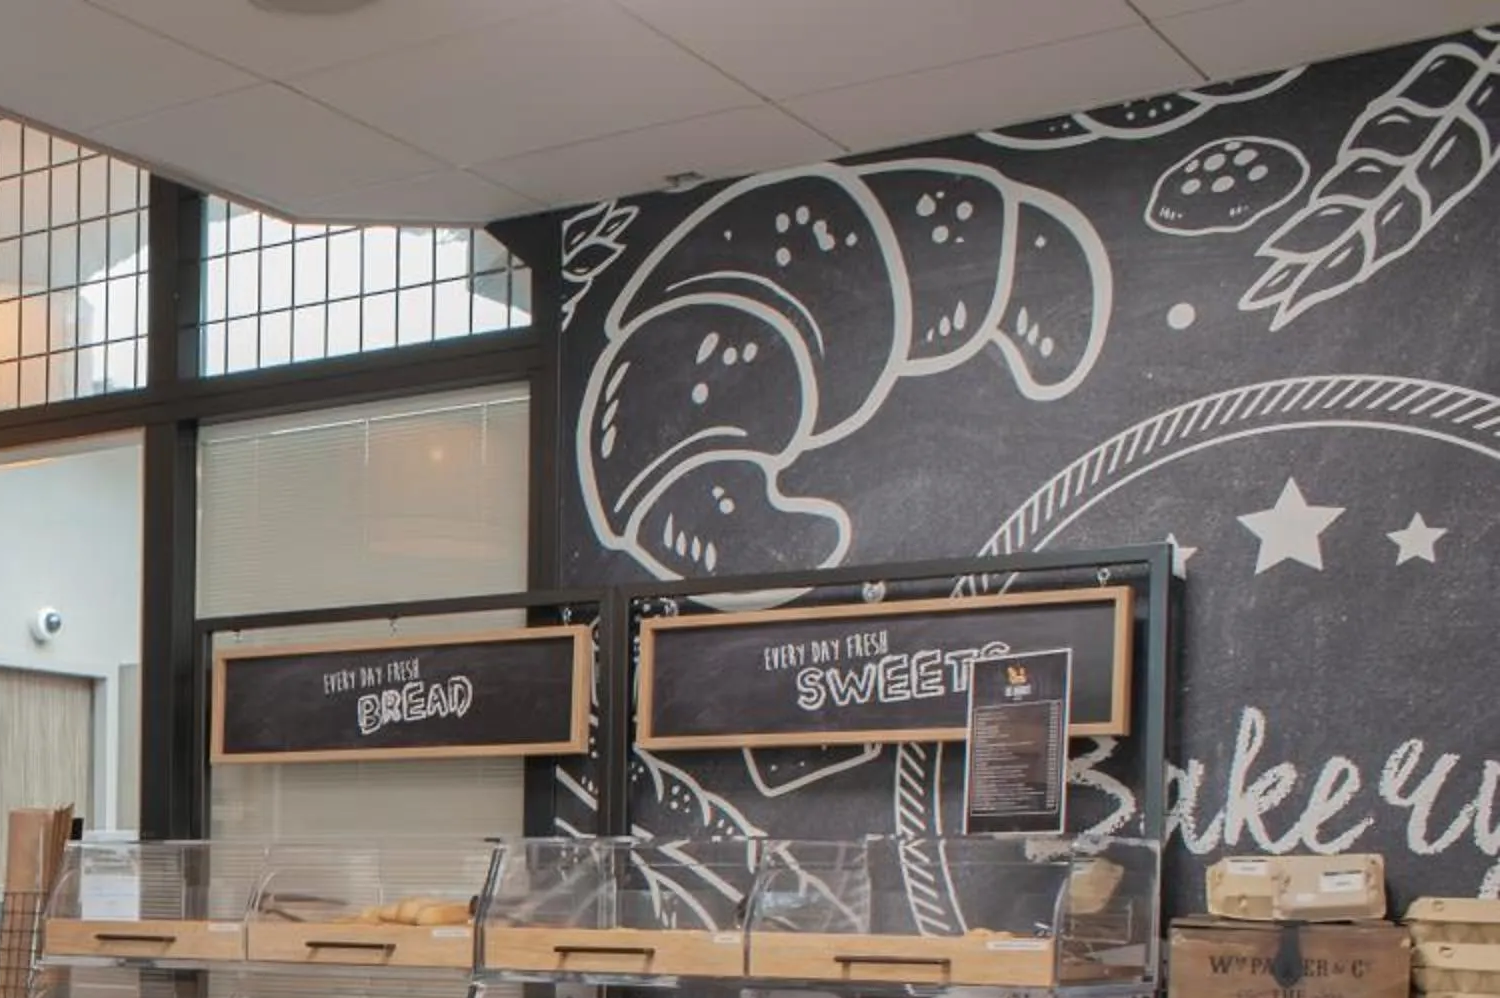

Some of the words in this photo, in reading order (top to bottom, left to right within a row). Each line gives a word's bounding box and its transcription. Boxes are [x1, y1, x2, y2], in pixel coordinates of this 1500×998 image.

[763, 641, 805, 671] EVERY
[811, 639, 841, 664] DAY
[846, 630, 889, 660] FRESH
[323, 670, 355, 695] EVERY
[359, 666, 383, 689] DAY
[387, 656, 420, 683] FRESH
[357, 675, 474, 735] BREAD
[1251, 957, 1329, 978] PAER
